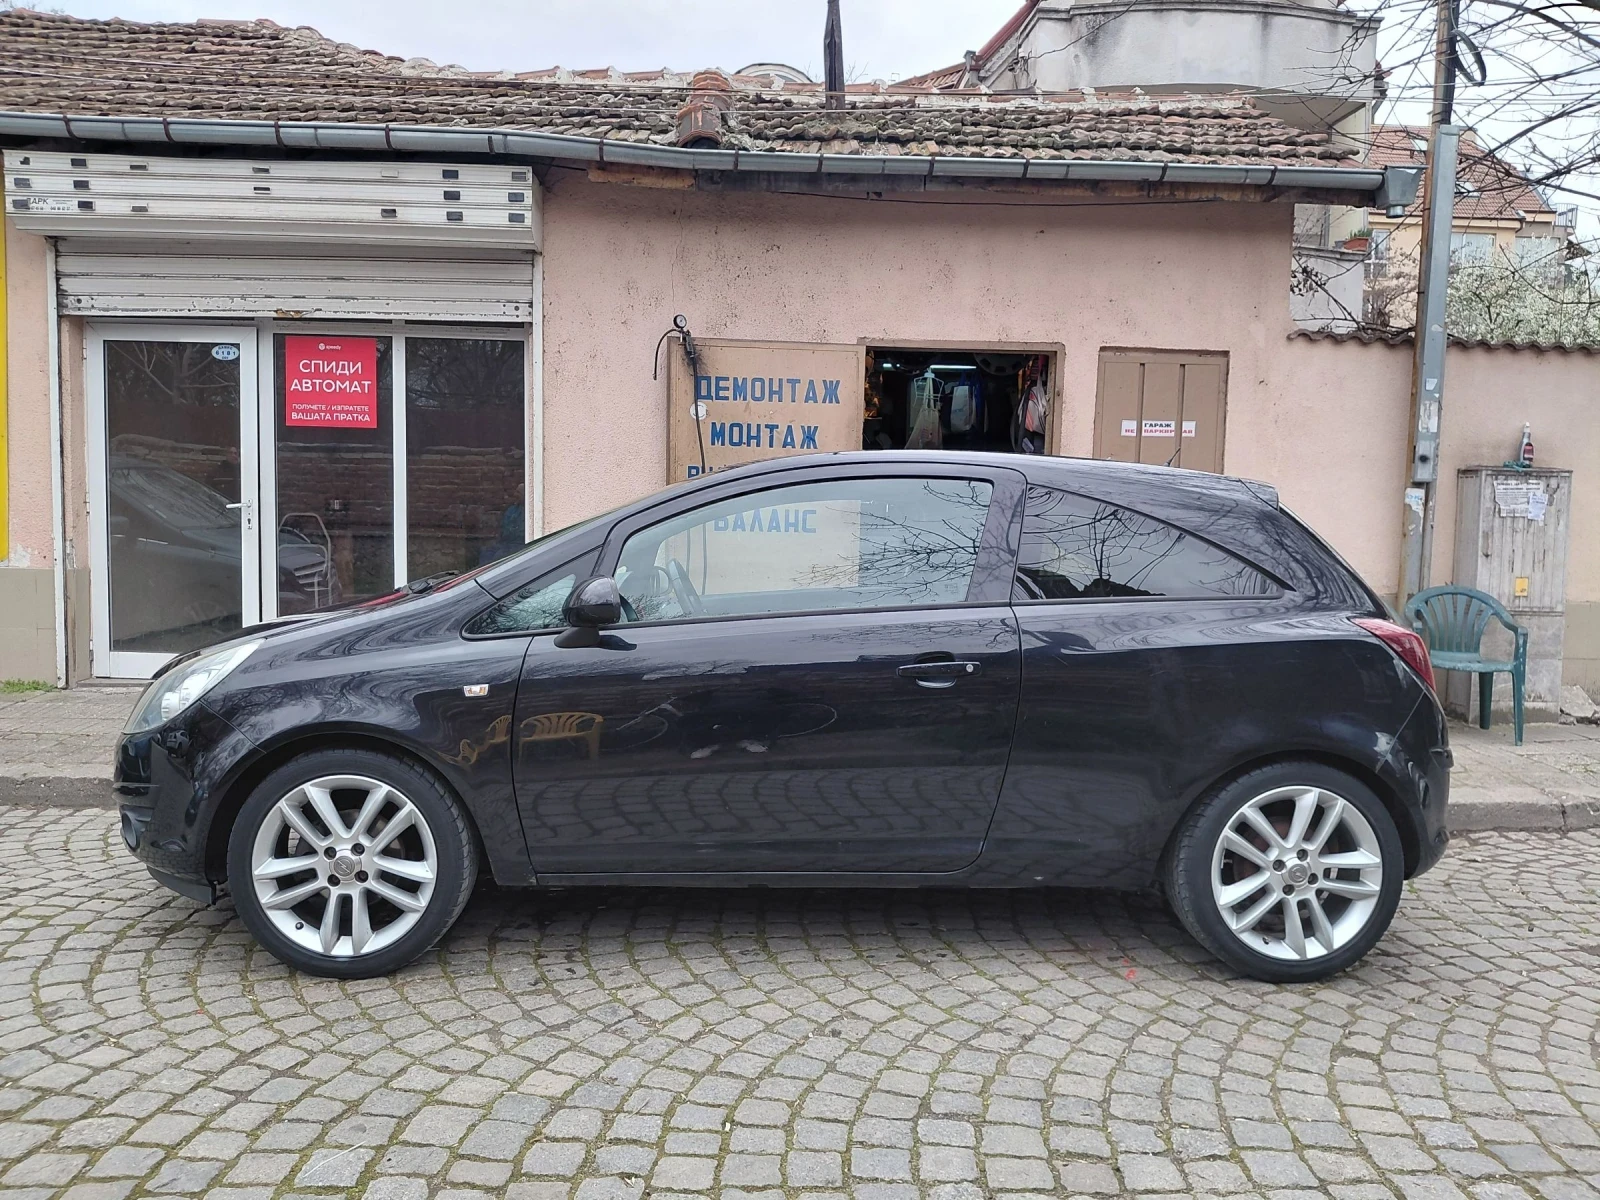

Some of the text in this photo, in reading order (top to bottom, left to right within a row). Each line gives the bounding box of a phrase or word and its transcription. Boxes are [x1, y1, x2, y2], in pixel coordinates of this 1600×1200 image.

[299, 359, 362, 376] СПИДИ
[290, 379, 372, 393] АВТОМАТ
[697, 375, 841, 405] ДЕМОНТАЖ
[292, 403, 326, 411] ПОЛУЧЕТЕ
[291, 412, 370, 422] ВАШАТА ПРАТКА
[710, 421, 819, 450] МОНТАЖ
